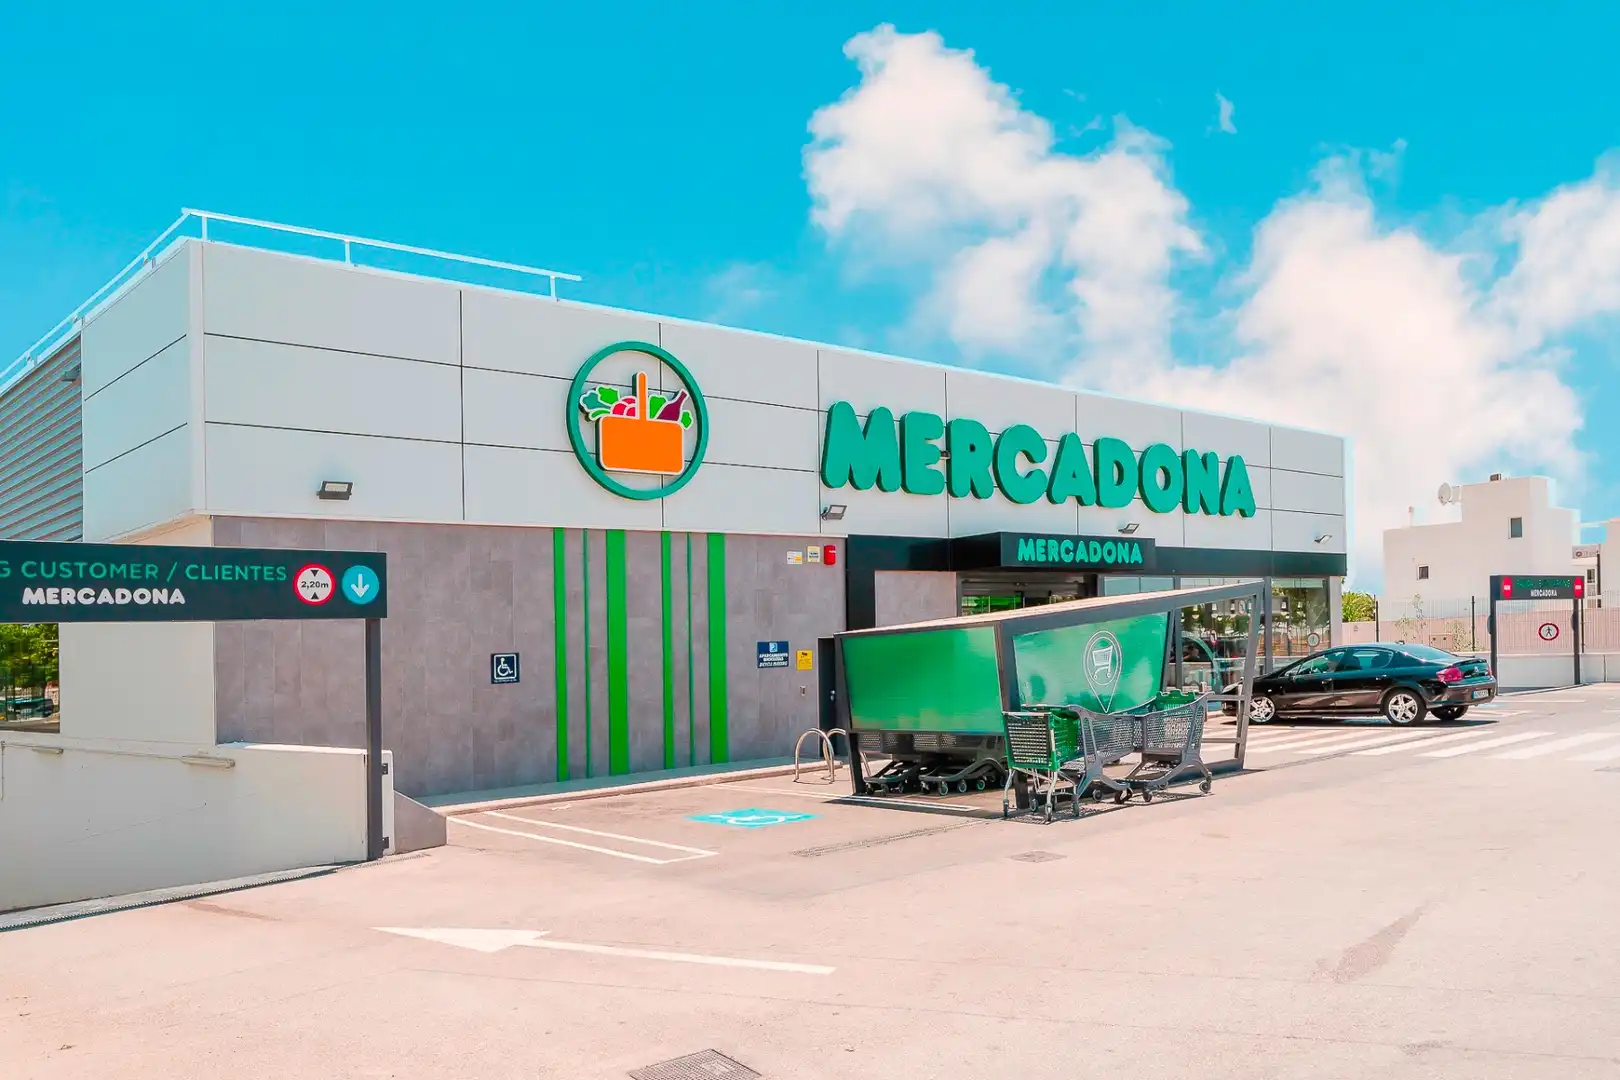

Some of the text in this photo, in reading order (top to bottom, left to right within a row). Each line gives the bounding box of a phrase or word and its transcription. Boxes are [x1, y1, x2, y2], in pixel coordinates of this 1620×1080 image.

[821, 401, 1256, 518] MERCADONA
[1017, 538, 1144, 564] MERCADONA
[21, 561, 159, 579] CUSTOMER
[185, 564, 287, 581] CLIENTES
[301, 581, 329, 590] 2,20m
[22, 587, 186, 605] MERCADONA
